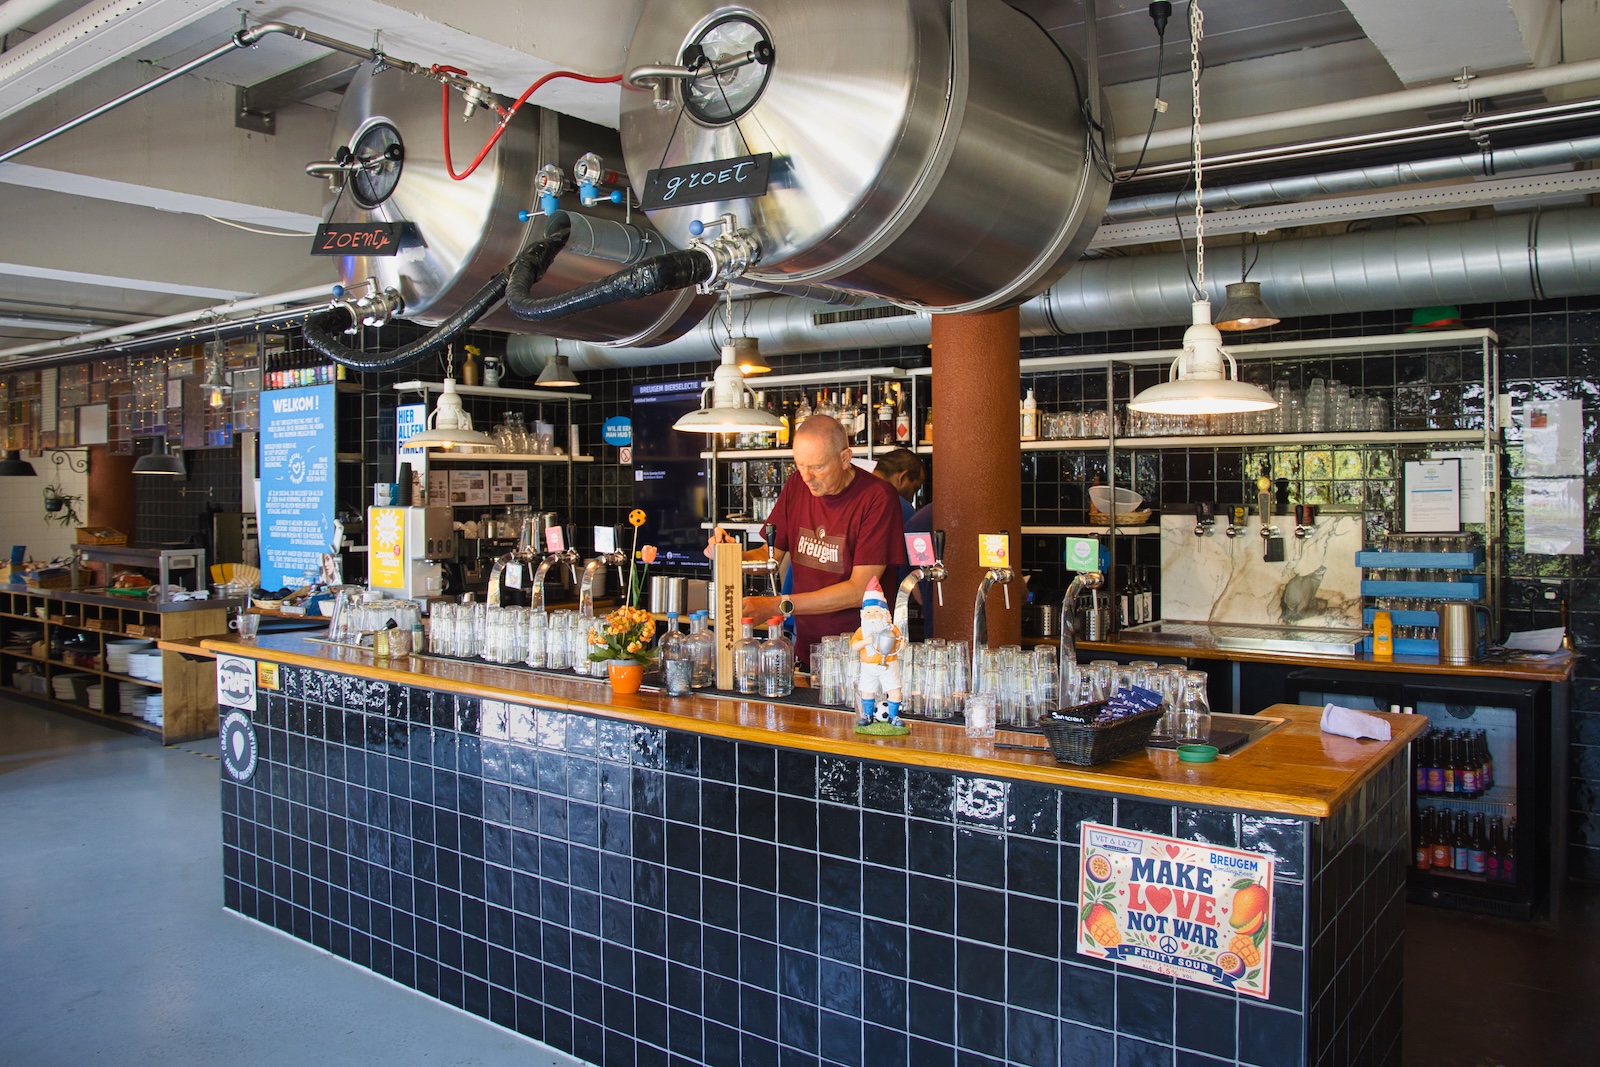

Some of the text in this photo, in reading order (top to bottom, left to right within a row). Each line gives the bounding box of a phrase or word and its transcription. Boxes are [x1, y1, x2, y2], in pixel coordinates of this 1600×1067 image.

[640, 382, 698, 393] BREUGEM BIERSELECTIE
[272, 395, 314, 413] WELKOM
[398, 409, 414, 424] HIER
[797, 535, 838, 563] Breugem
[219, 669, 254, 695] CRAFT
[1118, 839, 1137, 848] LAZY
[1210, 853, 1258, 872] BREUGEM
[1130, 857, 1213, 894] MAKE
[1127, 911, 1218, 949] NOT WAR
[1134, 947, 1208, 972] FRUITY SOUR
